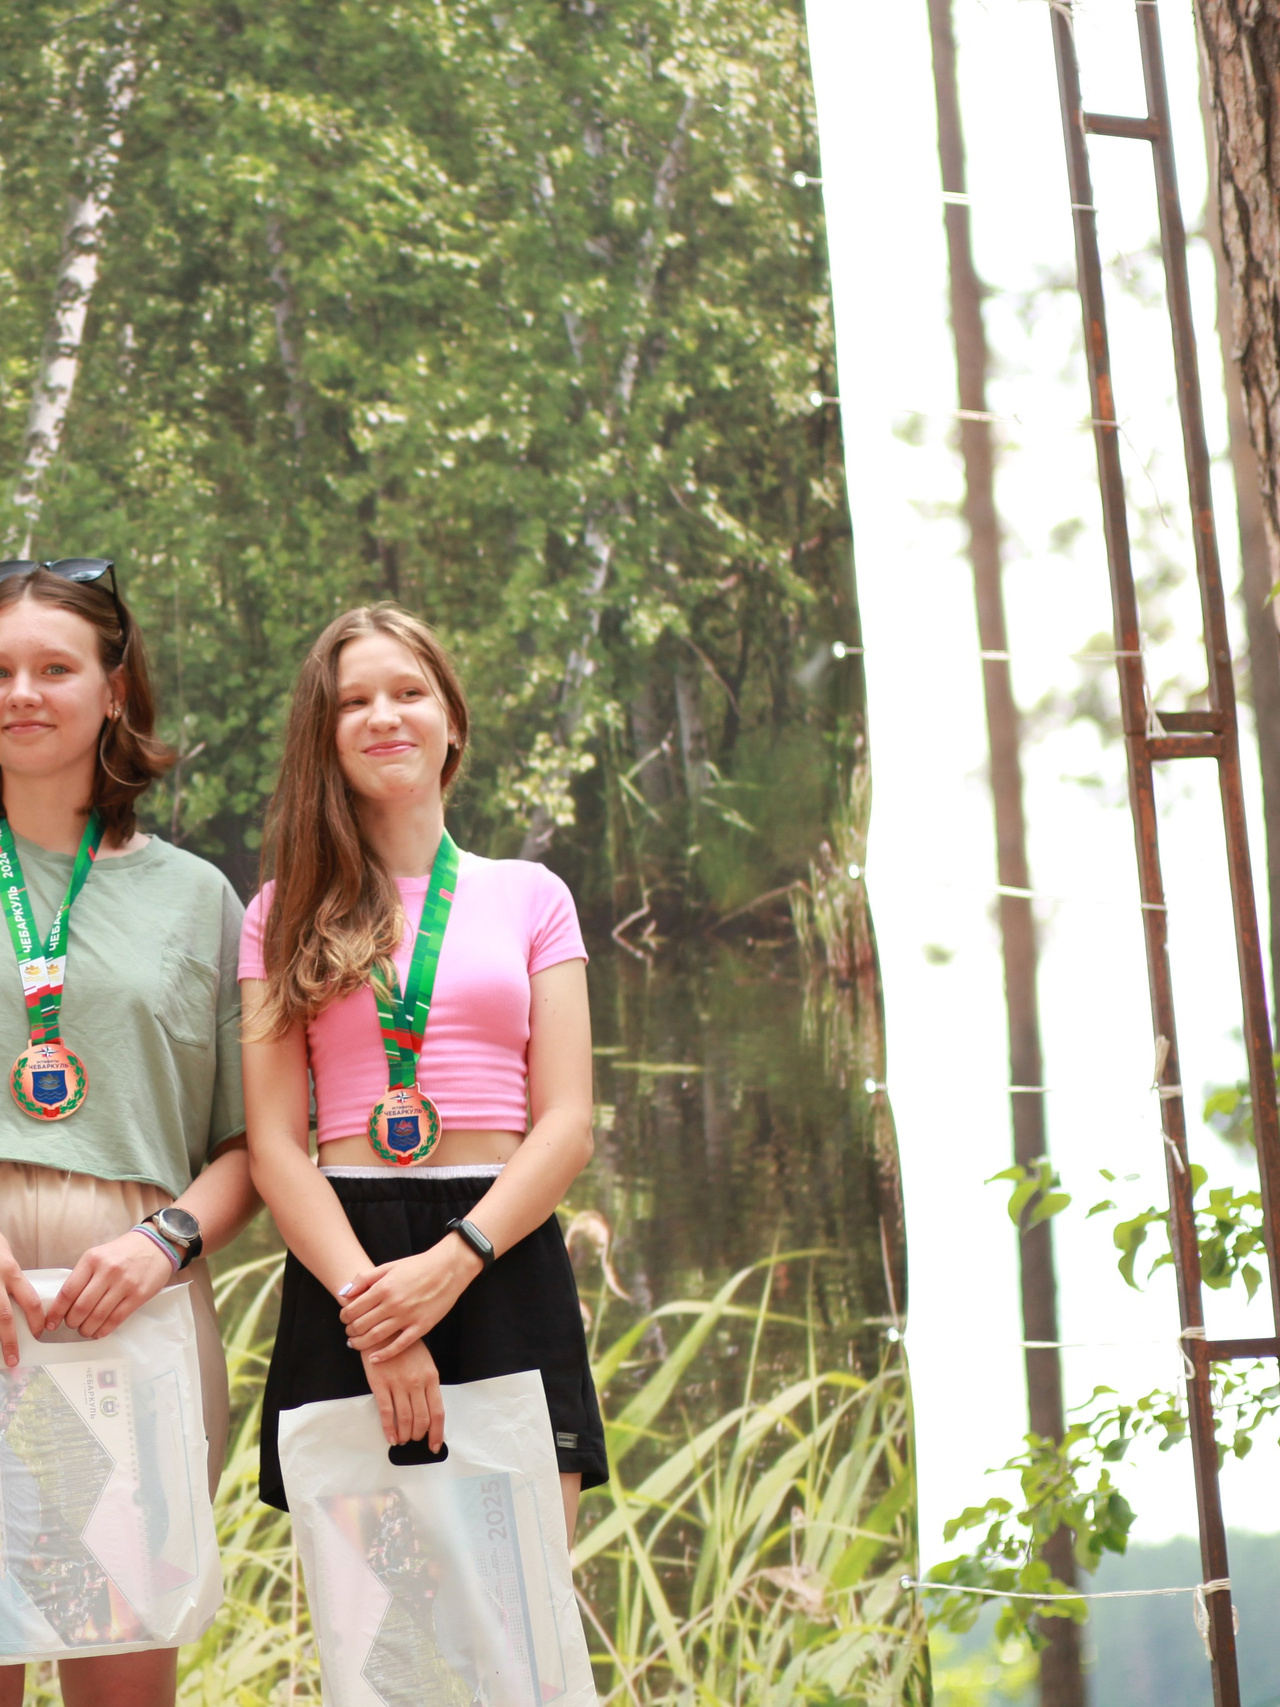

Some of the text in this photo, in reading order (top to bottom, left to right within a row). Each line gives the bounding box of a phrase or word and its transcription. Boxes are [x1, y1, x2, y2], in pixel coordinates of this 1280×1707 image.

[7, 885, 32, 953] ЧЕБАРКУЛЬ
[384, 1108, 422, 1116] ЧЕБАРКУЛЬ
[86, 1367, 97, 1420] ЧЕБАРКУЛЬ
[481, 1480, 508, 1541] 2025
